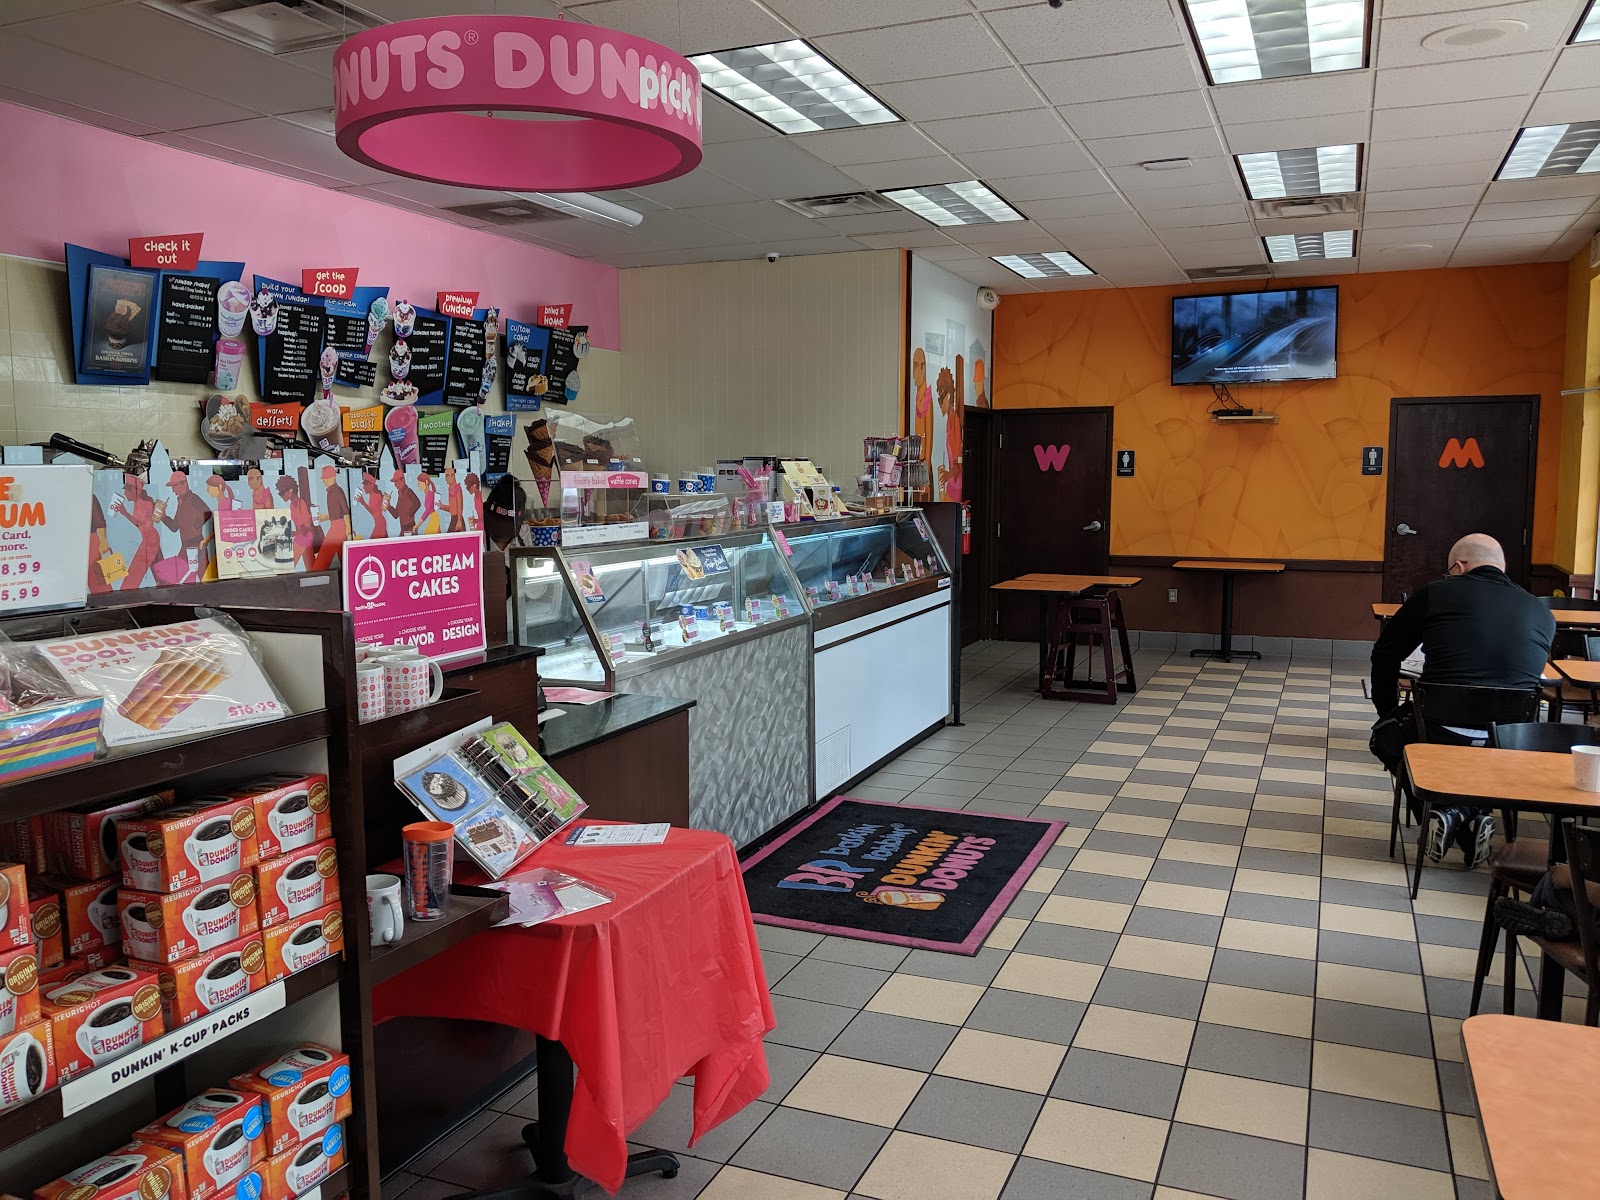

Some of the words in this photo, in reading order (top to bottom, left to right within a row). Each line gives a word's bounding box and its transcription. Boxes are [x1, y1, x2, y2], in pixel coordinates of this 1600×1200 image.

[640, 65, 693, 117] pick
[144, 241, 178, 253] check
[182, 240, 190, 251] it
[157, 253, 177, 264] out
[316, 271, 330, 281] get
[332, 271, 346, 281] the
[261, 282, 279, 291] build
[281, 286, 296, 294] your
[313, 281, 347, 295] scoop
[284, 294, 310, 303] sundae!
[445, 294, 473, 305] premium
[442, 301, 476, 317] sundaes
[544, 306, 559, 316] bring
[559, 306, 565, 315] it
[510, 325, 531, 334] custom
[544, 315, 565, 326] home
[513, 333, 531, 342] cakes
[256, 415, 293, 427] desserts
[347, 411, 378, 420] cappuccino
[350, 419, 375, 430] blasts
[1033, 444, 1071, 472] W
[1438, 437, 1485, 469] M
[2, 530, 31, 541] Card,
[391, 557, 418, 579] ICE
[421, 551, 475, 575] CREAM
[408, 575, 460, 600] CAKES
[393, 631, 435, 647] FLAVOR
[442, 622, 480, 642] DESIGN
[59, 647, 132, 667] POOL
[136, 631, 211, 651] FLOAT
[233, 813, 255, 831] ORIGINAL
[289, 821, 314, 837] DONUTS
[209, 840, 239, 859] DUNKIN'
[209, 849, 238, 865] DONUTS
[776, 859, 875, 893] BR
[232, 880, 254, 900] ORIGINAL
[297, 886, 322, 903] DONUTS
[34, 911, 60, 931] ORIGINAL
[208, 917, 237, 935] DONUTS
[170, 945, 178, 953] 12
[242, 946, 263, 967] ORIGINAL
[8, 962, 37, 987] ORIGINAL
[17, 974, 33, 986] BLEND
[134, 991, 160, 1014] ORIGINAL
[220, 984, 247, 1004] DONUTS
[142, 1001, 157, 1013] BLEND
[105, 1022, 142, 1046] DUNKIN'
[105, 1031, 140, 1053] DONUTS
[111, 1047, 166, 1084] DUNKIN'
[211, 1007, 251, 1036] PACKS
[0, 1070, 13, 1104] DONUTS
[308, 1107, 334, 1125] DONUTS
[225, 1150, 249, 1172] DONUTS
[305, 1166, 328, 1186] DONUTS
